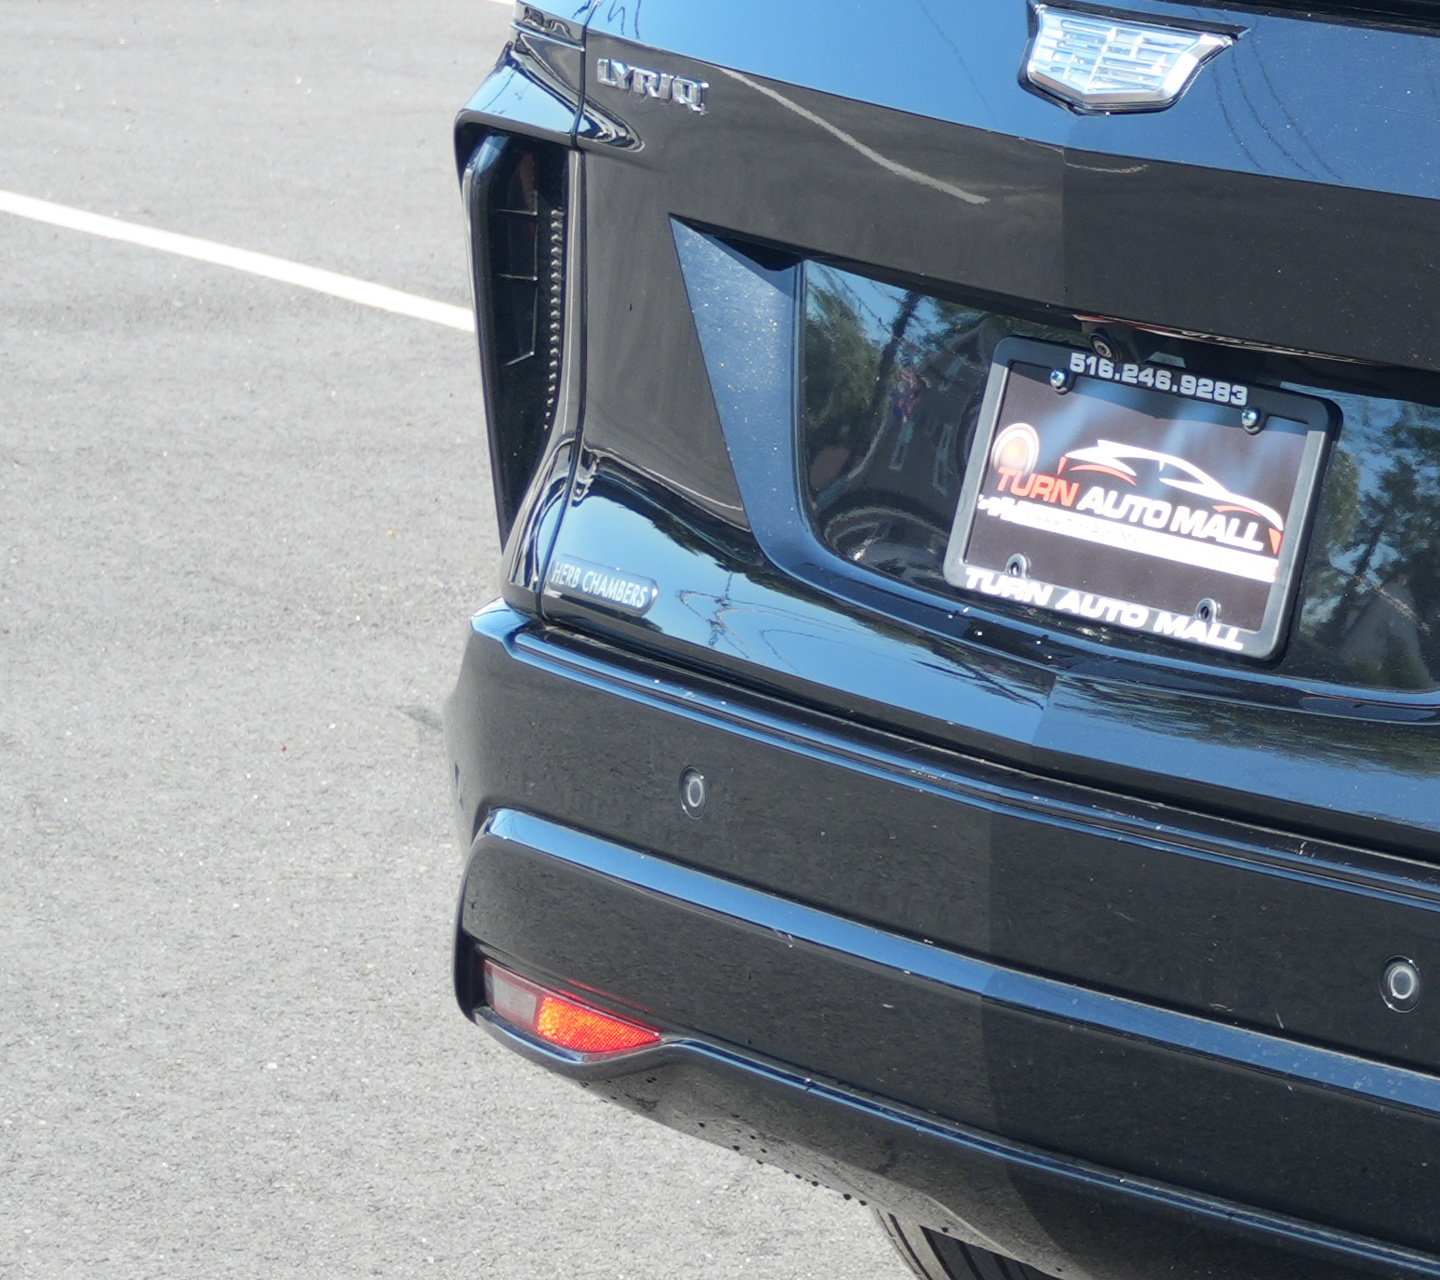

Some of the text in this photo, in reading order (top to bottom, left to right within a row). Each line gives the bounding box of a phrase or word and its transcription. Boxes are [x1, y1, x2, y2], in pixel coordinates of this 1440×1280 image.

[597, 58, 709, 115] LYRIQ
[1069, 353, 1248, 407] 516.246.9283
[996, 466, 1080, 507] TURN
[1078, 486, 1176, 529] AUTO
[1172, 506, 1264, 552] MALL
[551, 562, 649, 609] HERB CHAMBERS
[964, 567, 1244, 651] TURN AUTO MALL
